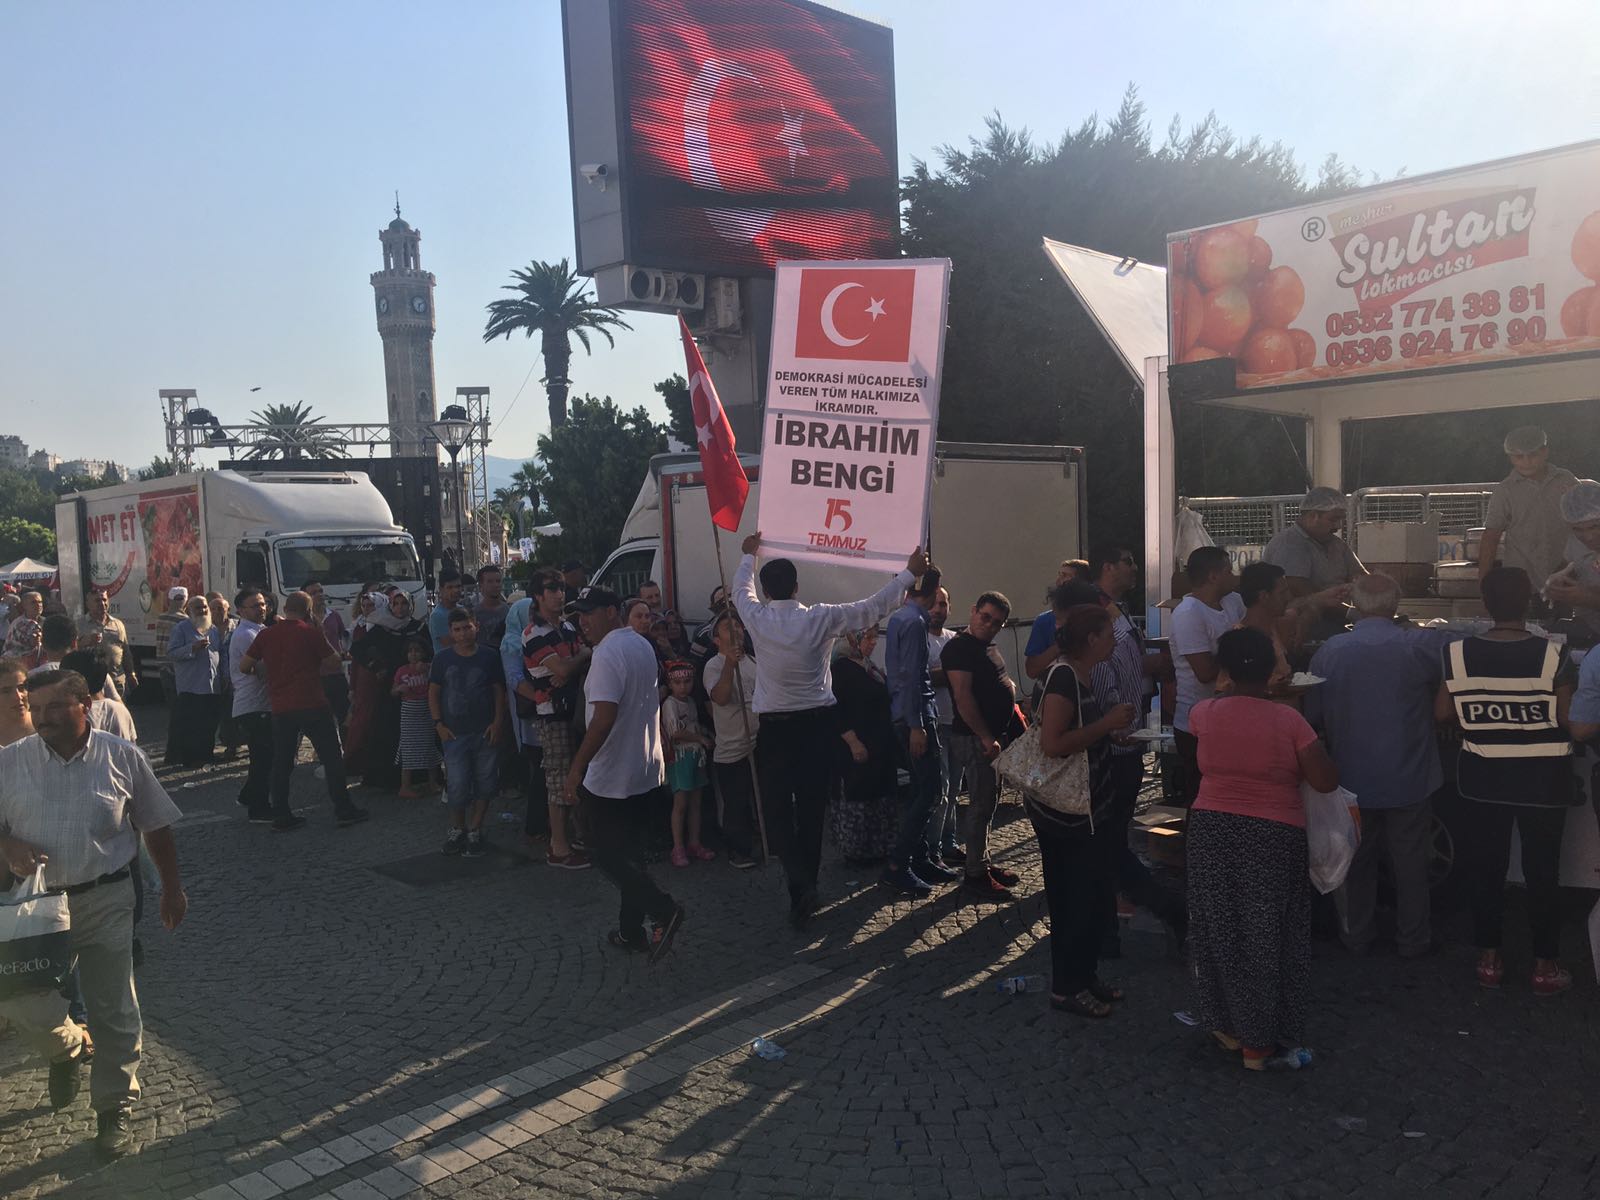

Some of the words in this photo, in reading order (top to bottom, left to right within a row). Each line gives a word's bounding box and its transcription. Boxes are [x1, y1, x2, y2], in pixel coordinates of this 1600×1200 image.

[1338, 195, 1536, 287] Sultan
[1325, 305, 1394, 338] 0532
[1400, 296, 1455, 328] 774
[1462, 289, 1501, 320] 38
[1508, 282, 1546, 314] 81
[1325, 335, 1393, 368] 0536
[1400, 327, 1454, 359] 924
[1460, 321, 1499, 351] 76
[1506, 315, 1547, 346] 90
[774, 371, 844, 384] DEMOKRASİ
[847, 373, 928, 388] MÜCADELESİ
[779, 385, 818, 397] VEREN
[821, 386, 847, 399] TÜM
[851, 389, 920, 403] HALKIMIZA
[815, 400, 878, 415] İKRAMDIR.
[774, 413, 920, 456] İBRAHİM
[790, 458, 895, 494] BENGİ
[120, 511, 136, 542] ET
[824, 497, 853, 532] 15
[808, 532, 868, 551] TEMMUZ
